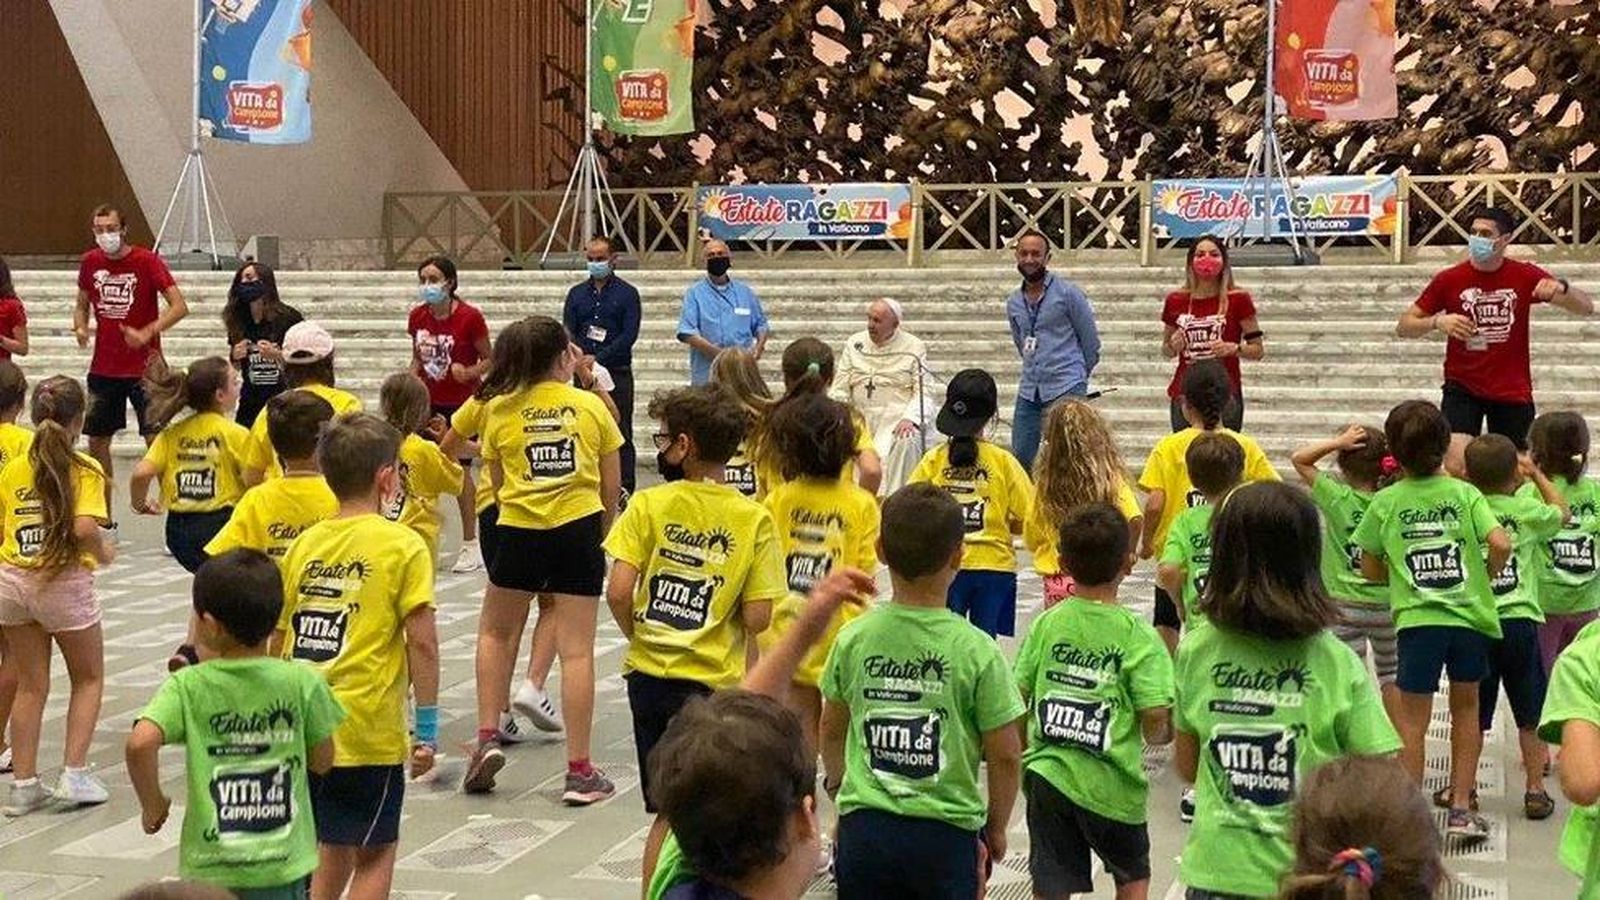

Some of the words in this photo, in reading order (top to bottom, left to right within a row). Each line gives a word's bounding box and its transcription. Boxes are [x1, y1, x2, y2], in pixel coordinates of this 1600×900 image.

[1306, 62, 1338, 80] VITA
[1339, 69, 1352, 81] da
[232, 91, 263, 108] VITA
[265, 98, 278, 109] da
[621, 81, 648, 98] VITA
[650, 87, 662, 99] da
[718, 193, 786, 224] Estate
[786, 200, 888, 221] RAGAZZI
[1177, 189, 1253, 221] Estate
[1254, 194, 1370, 216] RAGAZZI
[829, 222, 870, 233] Vaticano
[1302, 218, 1350, 229] Vaticano
[531, 446, 559, 461] VITA
[180, 473, 202, 485] VITA
[725, 469, 741, 481] ITA
[664, 523, 708, 549] Estate
[1553, 542, 1578, 556] VITA
[1412, 553, 1443, 570] VITA
[1444, 557, 1457, 568] da
[657, 580, 690, 605] VITA
[690, 595, 704, 609] da
[300, 616, 331, 636] VITA
[864, 655, 920, 680] Estate
[1052, 643, 1102, 670] Estate
[1211, 662, 1274, 691] Estate
[210, 711, 266, 734] Estate
[1047, 702, 1084, 729] VITA
[1086, 718, 1102, 733] da
[870, 724, 911, 749] VITA
[915, 734, 932, 750] da
[1217, 742, 1264, 770] VITA
[1268, 753, 1287, 772] da
[217, 778, 262, 804] VITA
[267, 784, 284, 802] da
